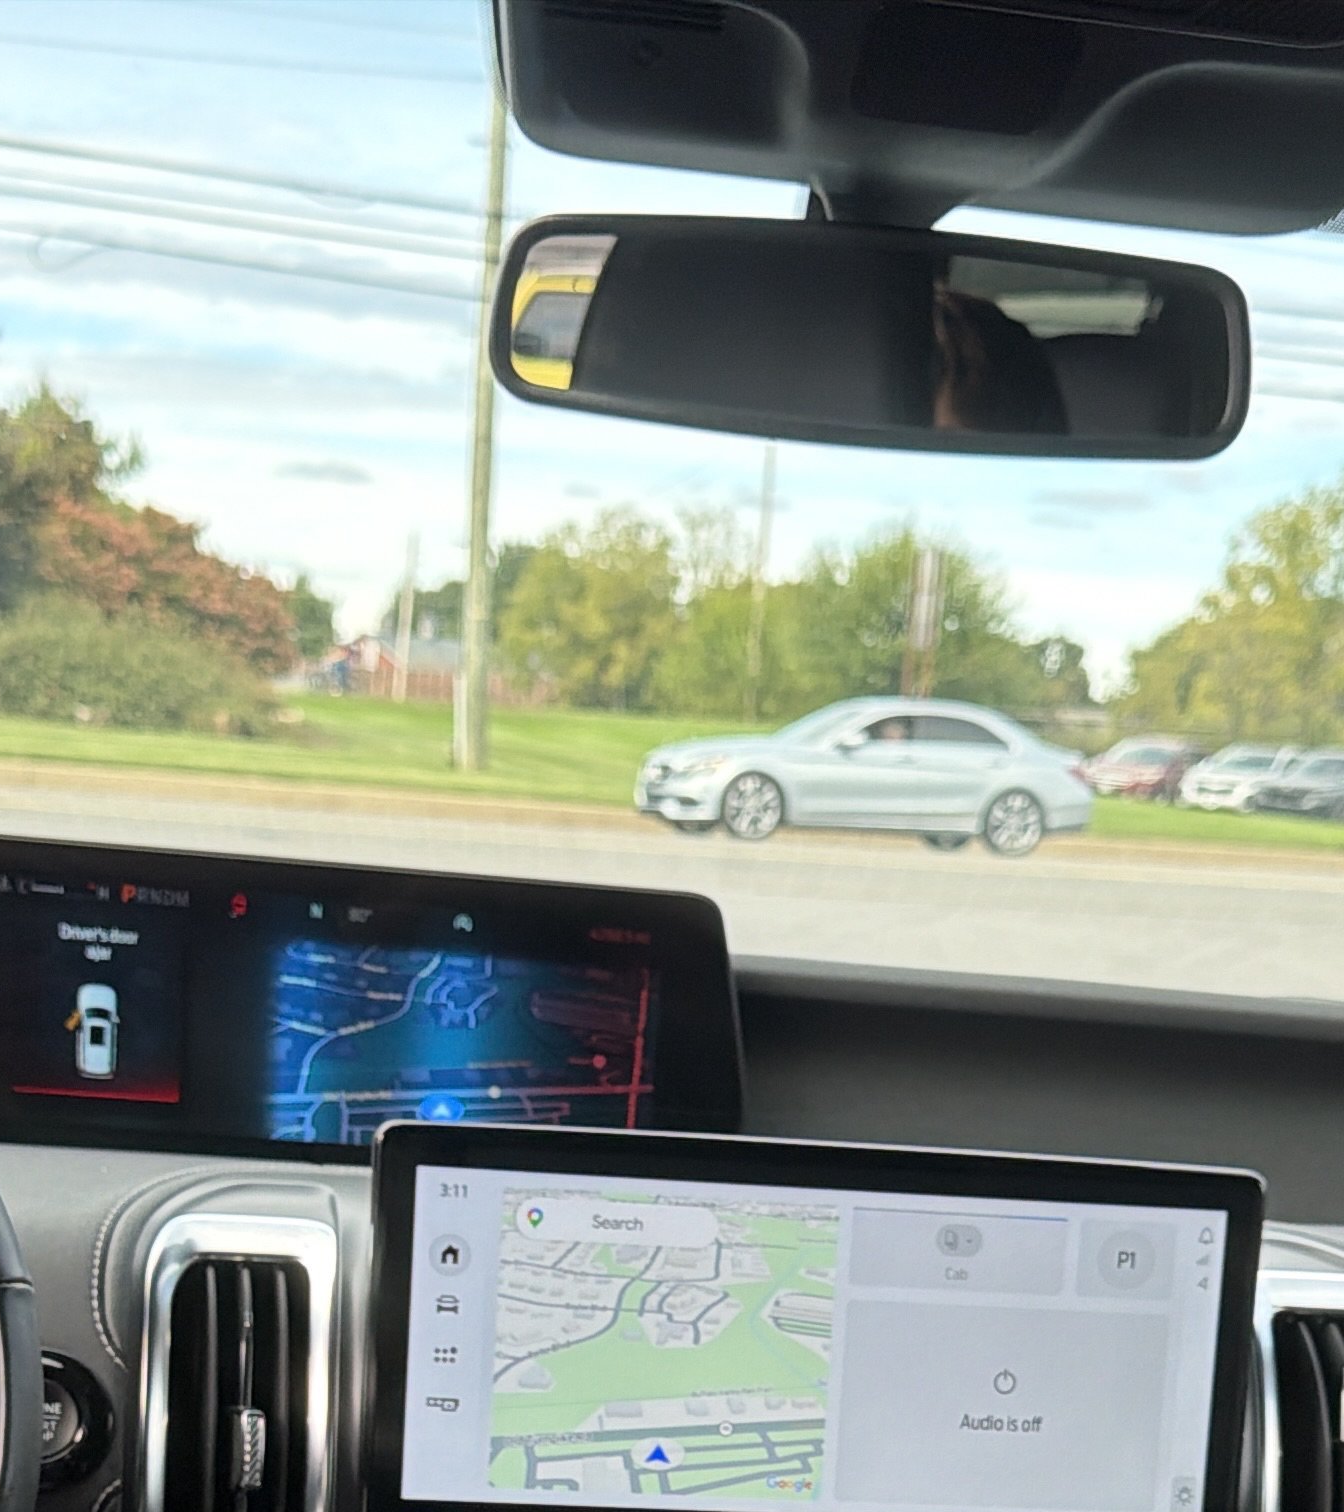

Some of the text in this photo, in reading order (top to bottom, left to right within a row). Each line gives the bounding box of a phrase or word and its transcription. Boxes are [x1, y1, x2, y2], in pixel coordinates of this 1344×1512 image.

[439, 1183, 469, 1198] 3:11
[591, 1214, 644, 1232] Search
[1116, 1251, 1137, 1270] P1
[944, 1267, 969, 1282] Cab
[959, 1413, 1043, 1433] Audio is off
[766, 1476, 814, 1494] Google
